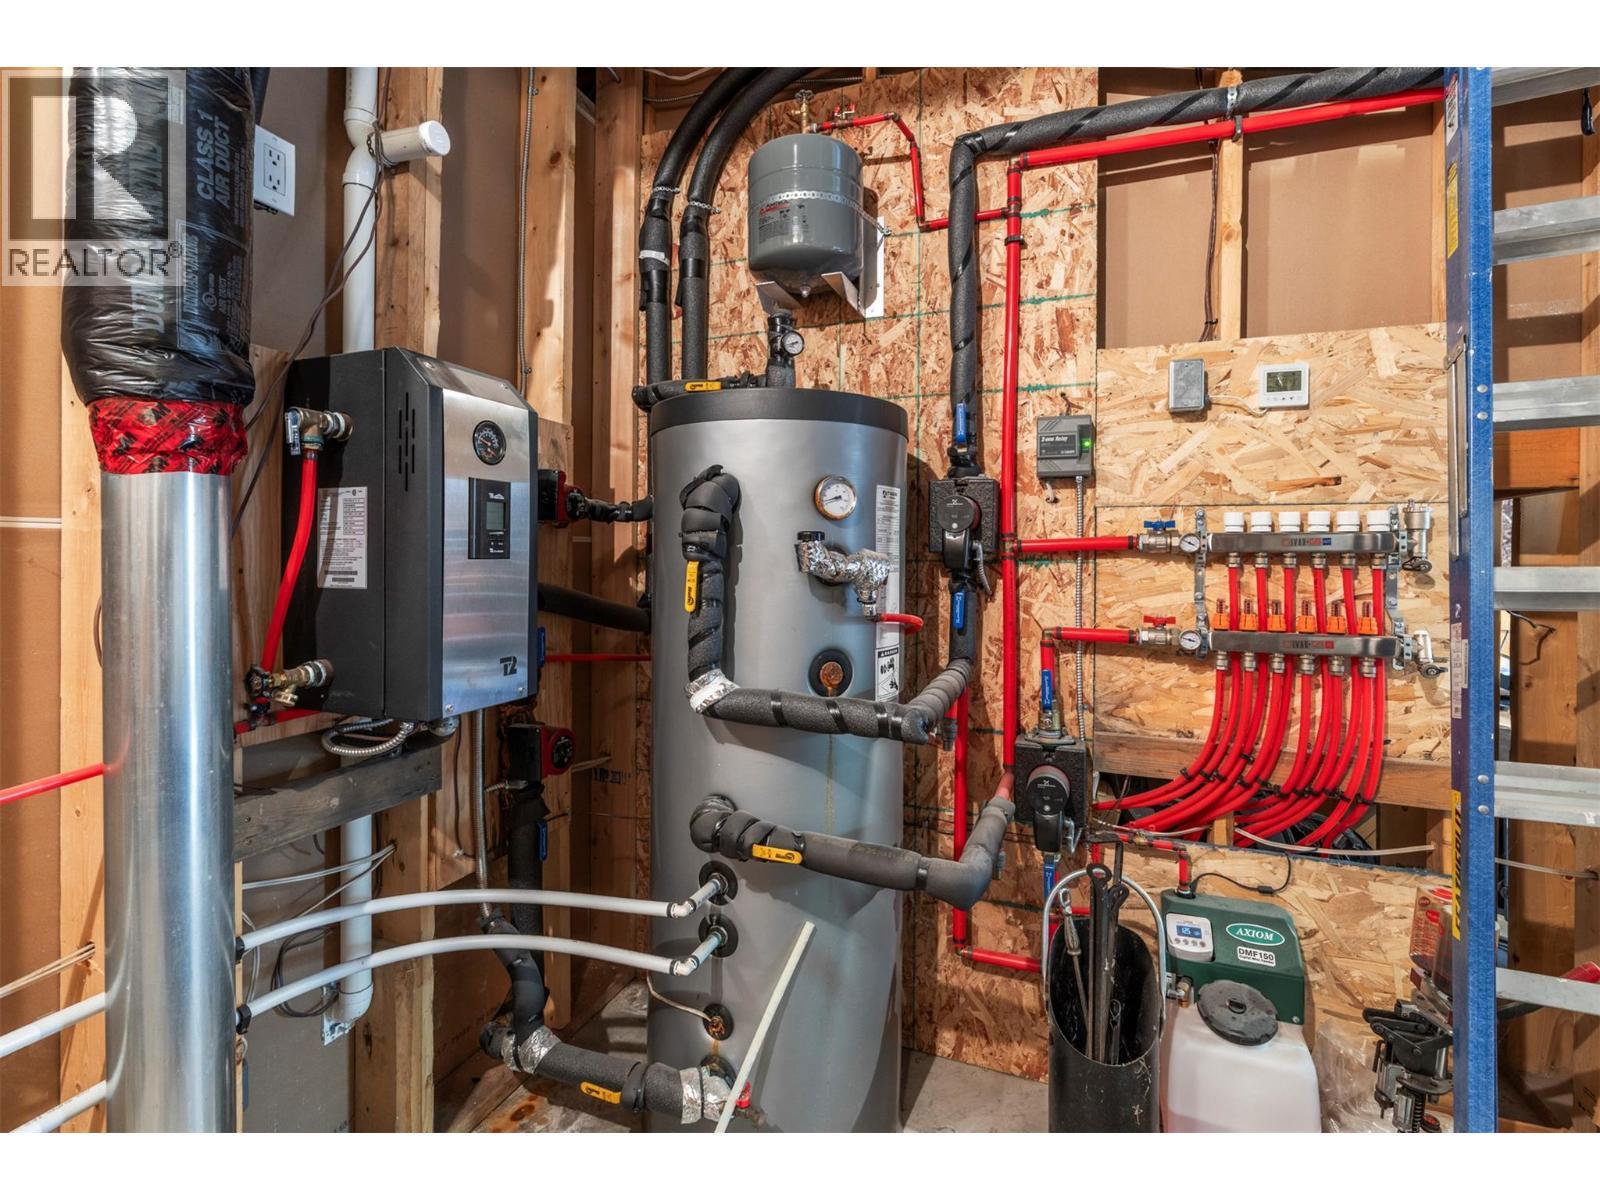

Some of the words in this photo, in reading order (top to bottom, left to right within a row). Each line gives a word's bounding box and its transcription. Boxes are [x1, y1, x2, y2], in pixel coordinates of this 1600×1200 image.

[197, 109, 213, 121] 1
[214, 115, 230, 172] DUCT
[196, 126, 214, 200] CLASS
[214, 173, 230, 208] AIR
[1236, 927, 1274, 941] AXIOM
[1238, 948, 1274, 961] DMF150
